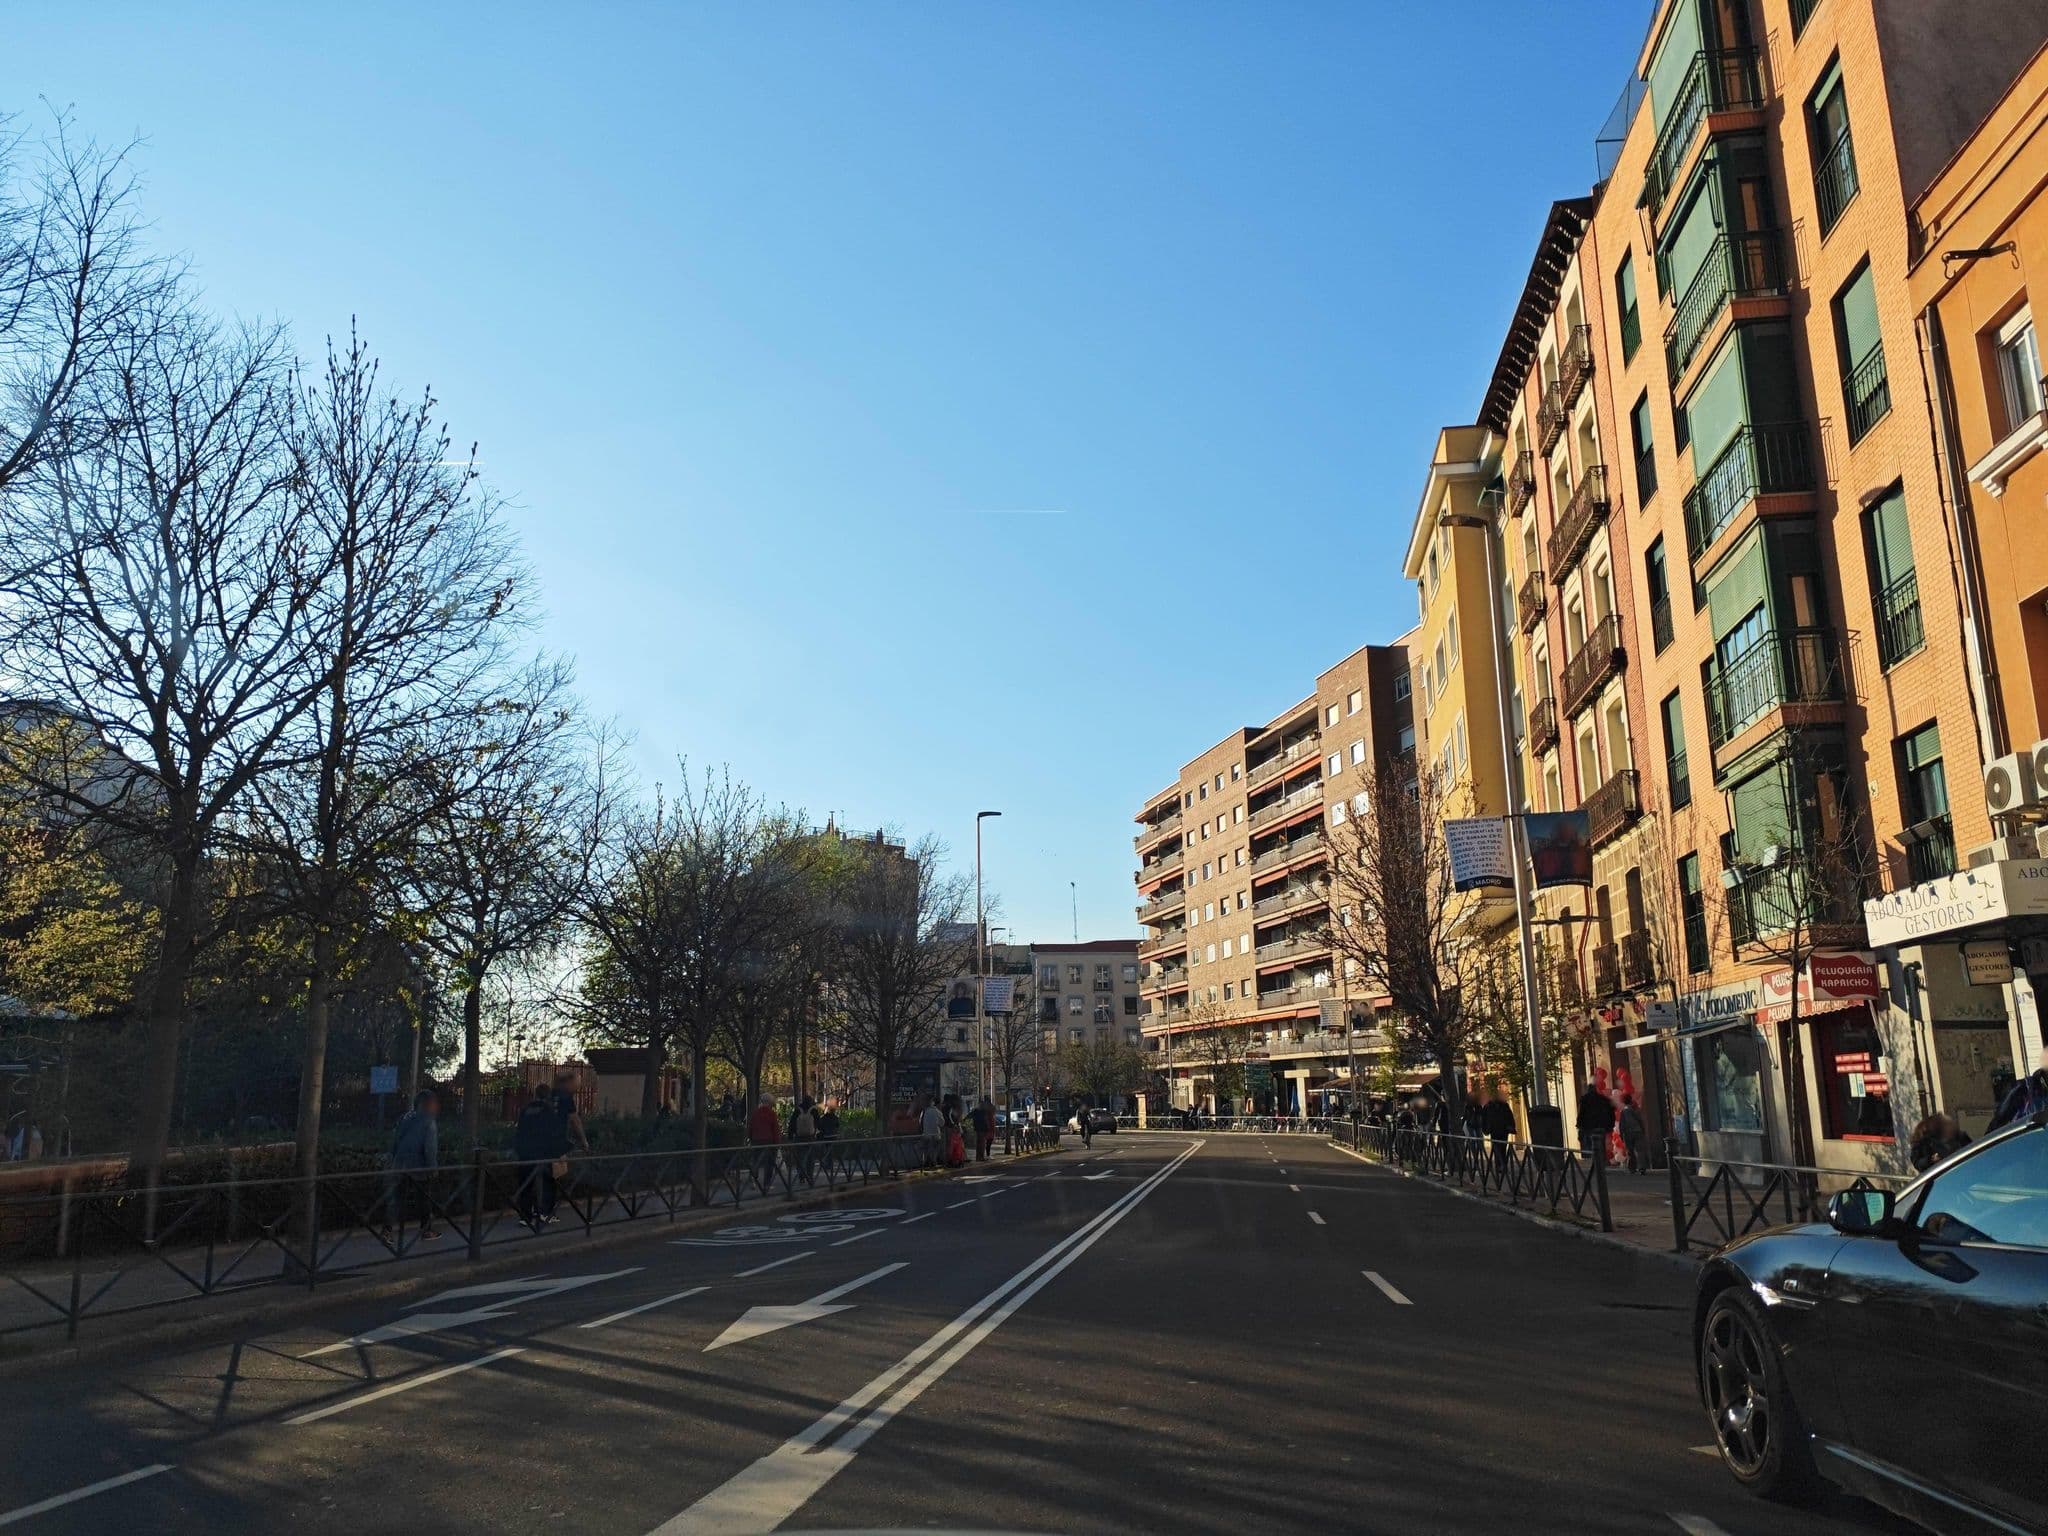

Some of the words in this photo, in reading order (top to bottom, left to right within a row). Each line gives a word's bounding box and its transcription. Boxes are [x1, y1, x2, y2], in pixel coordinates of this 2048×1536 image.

[1948, 883, 1958, 902] &
[1905, 901, 1975, 935] GESTORES
[1821, 978, 1869, 987] KAPRICHO
